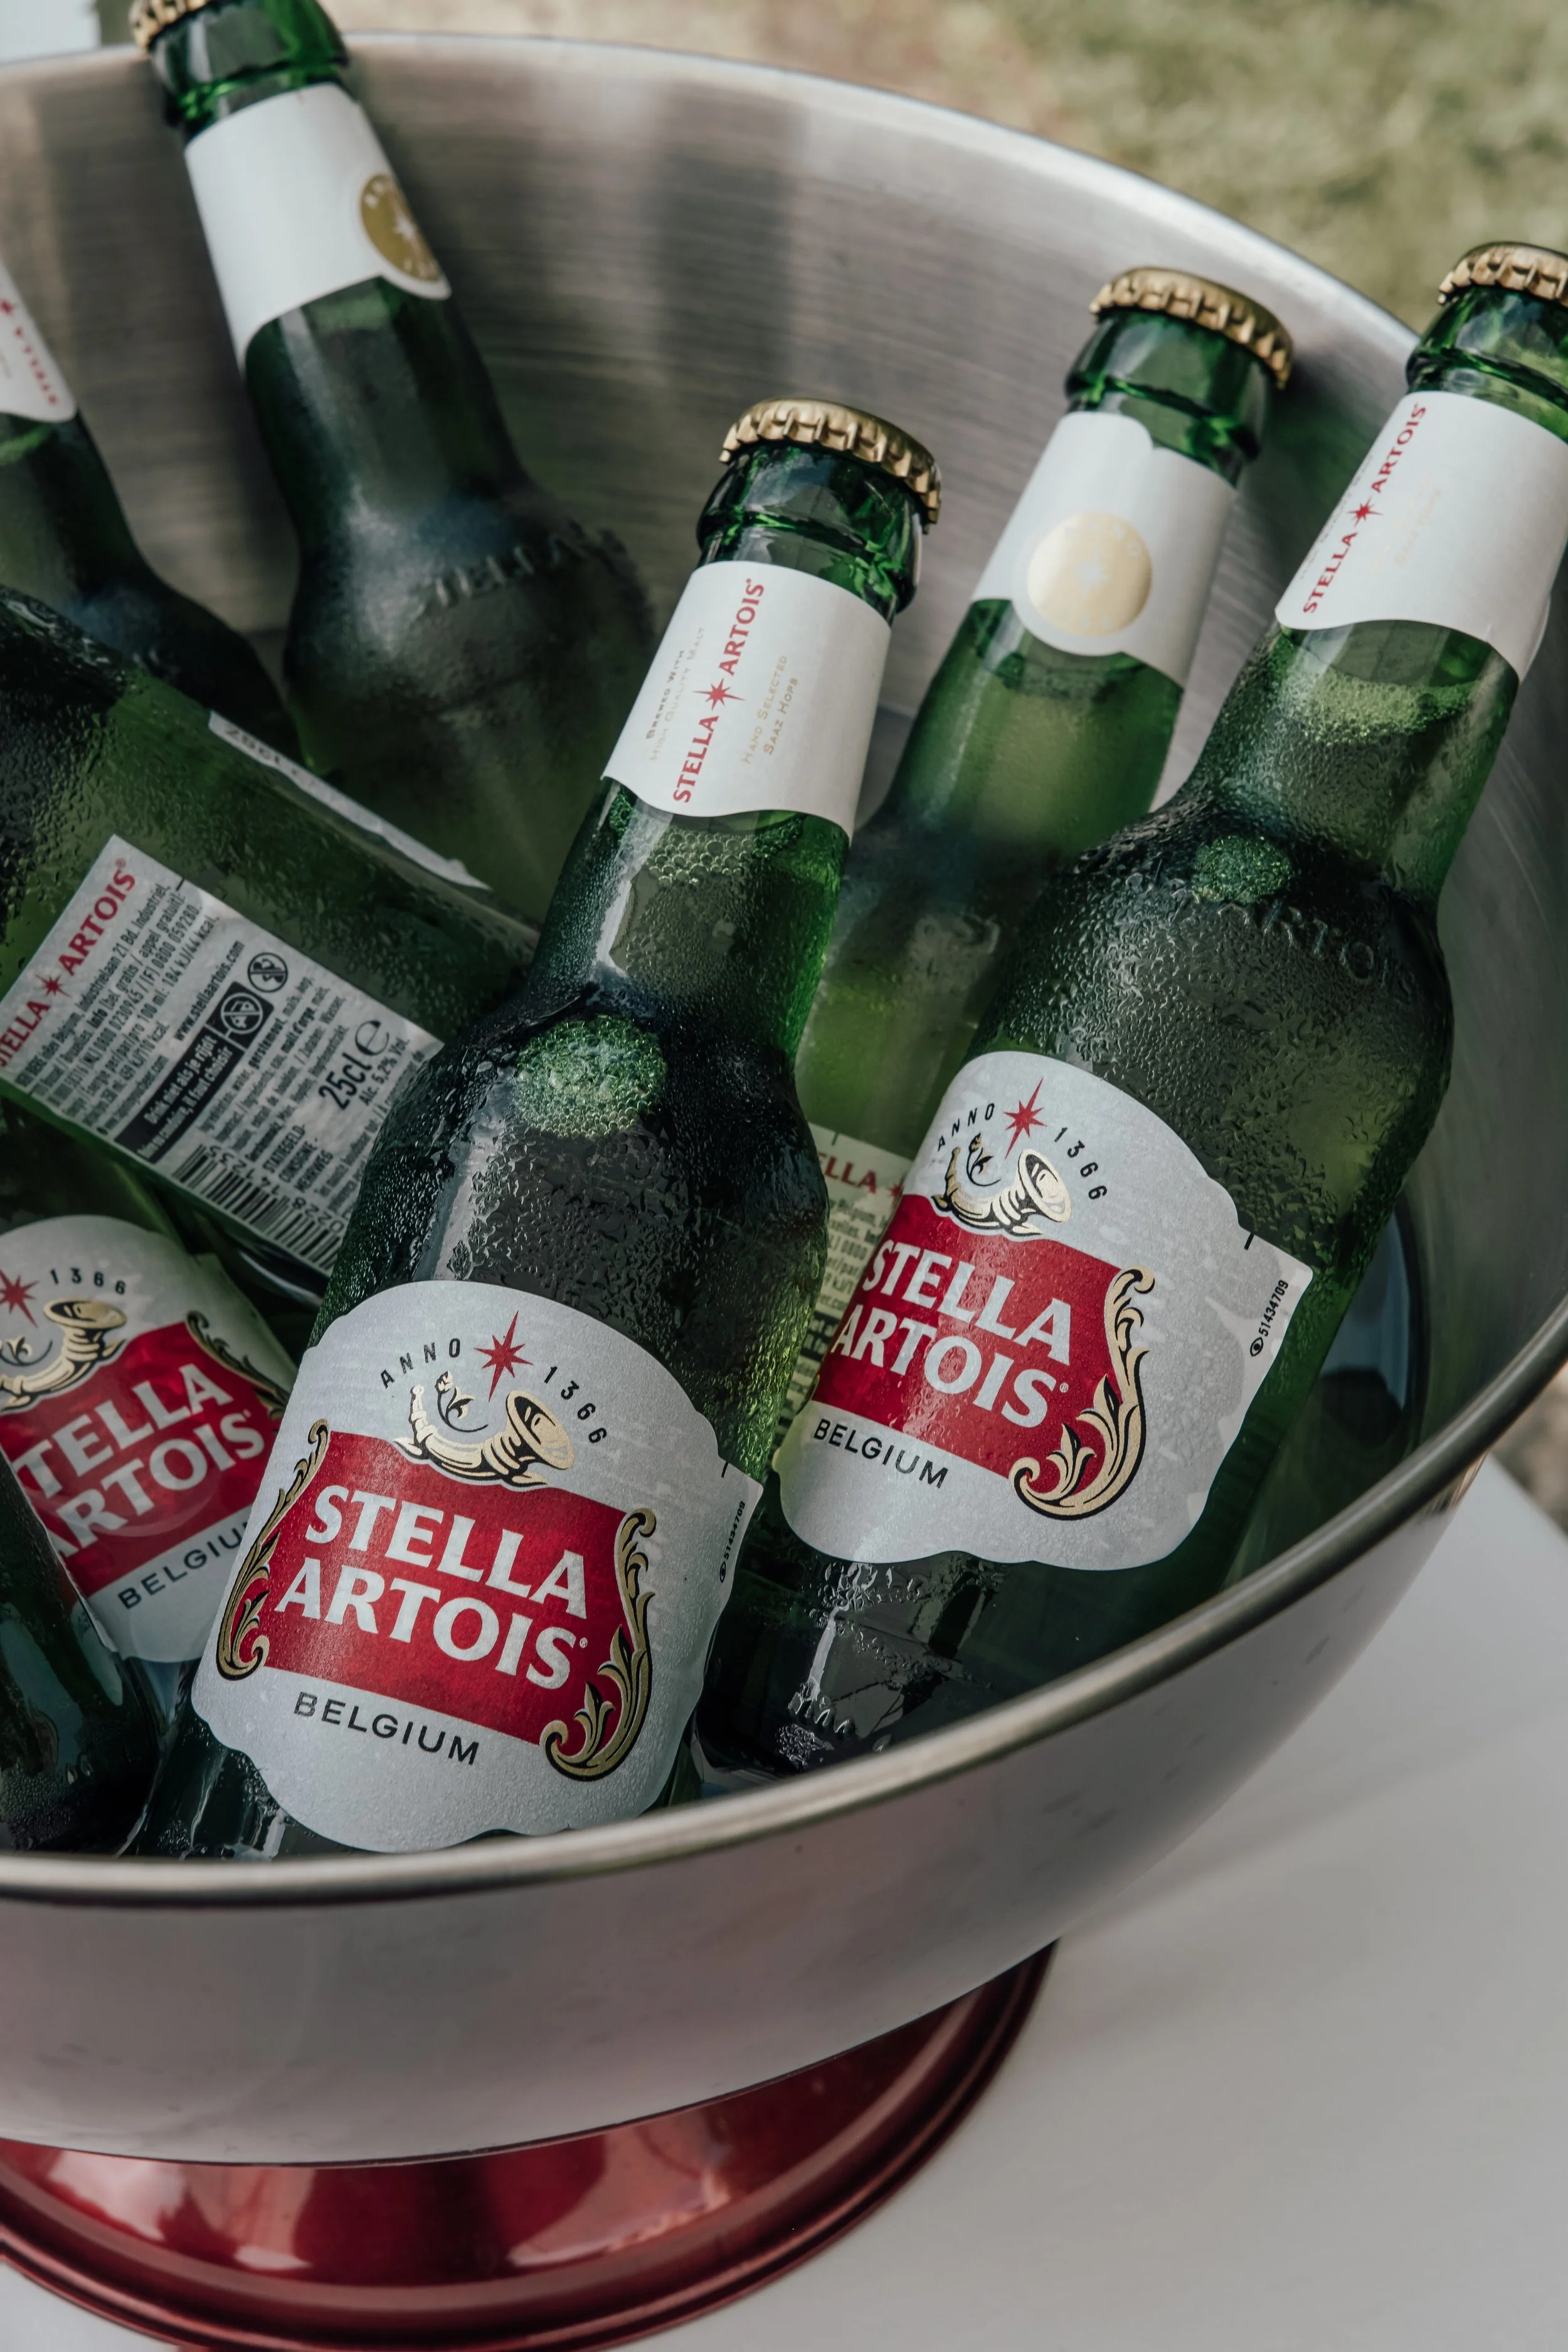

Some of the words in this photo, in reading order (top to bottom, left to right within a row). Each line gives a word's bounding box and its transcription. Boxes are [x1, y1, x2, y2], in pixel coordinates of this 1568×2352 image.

[1303, 532, 1358, 614] STELLA
[1371, 403, 1427, 494] ARTOIS
[758, 655, 788, 721] SELECTED
[781, 677, 798, 714] HOPS
[673, 715, 719, 803] STELLA
[120, 928, 140, 945] Bd.
[130, 883, 170, 928] Industriel,
[86, 1008, 108, 1029] Info
[98, 988, 120, 1010] (bel
[115, 964, 139, 993] gratis
[139, 929, 161, 958] appel
[108, 989, 144, 1030] 0230945
[139, 966, 160, 985] (F)
[151, 941, 176, 968] 0800
[166, 904, 199, 943] 059280.
[112, 942, 129, 958] 21
[137, 1003, 157, 1020] 100
[152, 989, 167, 1006] ml:
[161, 967, 182, 987] 184
[174, 939, 201, 969] kJ/44
[75, 956, 120, 1012] Industrielaan
[174, 941, 243, 1041] www.stellaartois.com
[184, 1058, 201, 1074] je
[188, 1078, 210, 1099] faut
[204, 1046, 232, 1081] choisir
[194, 1035, 216, 1061] rijdt
[248, 1018, 285, 1069] gerstemout,
[280, 1031, 299, 1054] malt
[358, 1086, 378, 1106] Alc.
[371, 1057, 398, 1084] 5,2%
[388, 1037, 408, 1056] Vol.
[176, 1069, 193, 1086] als
[318, 1052, 372, 1110] 25cl
[294, 1150, 333, 1192] MEHRWEG
[938, 1103, 997, 1152] ANNO
[1054, 1126, 1108, 1202] 1366
[50, 1268, 127, 1296] 1366
[864, 1240, 1072, 1366] STELLA
[1258, 1279, 1289, 1337] 51434709
[381, 1338, 461, 1389] ANNO
[544, 1365, 608, 1446] 1366
[12, 1363, 233, 1500] TELLA
[814, 1419, 949, 1490] BELGIUM
[305, 1485, 588, 1619] STELLA
[724, 1500, 746, 1560] 51434709
[117, 1521, 248, 1609] BELGIU
[294, 1692, 480, 1765] BELGIUM
